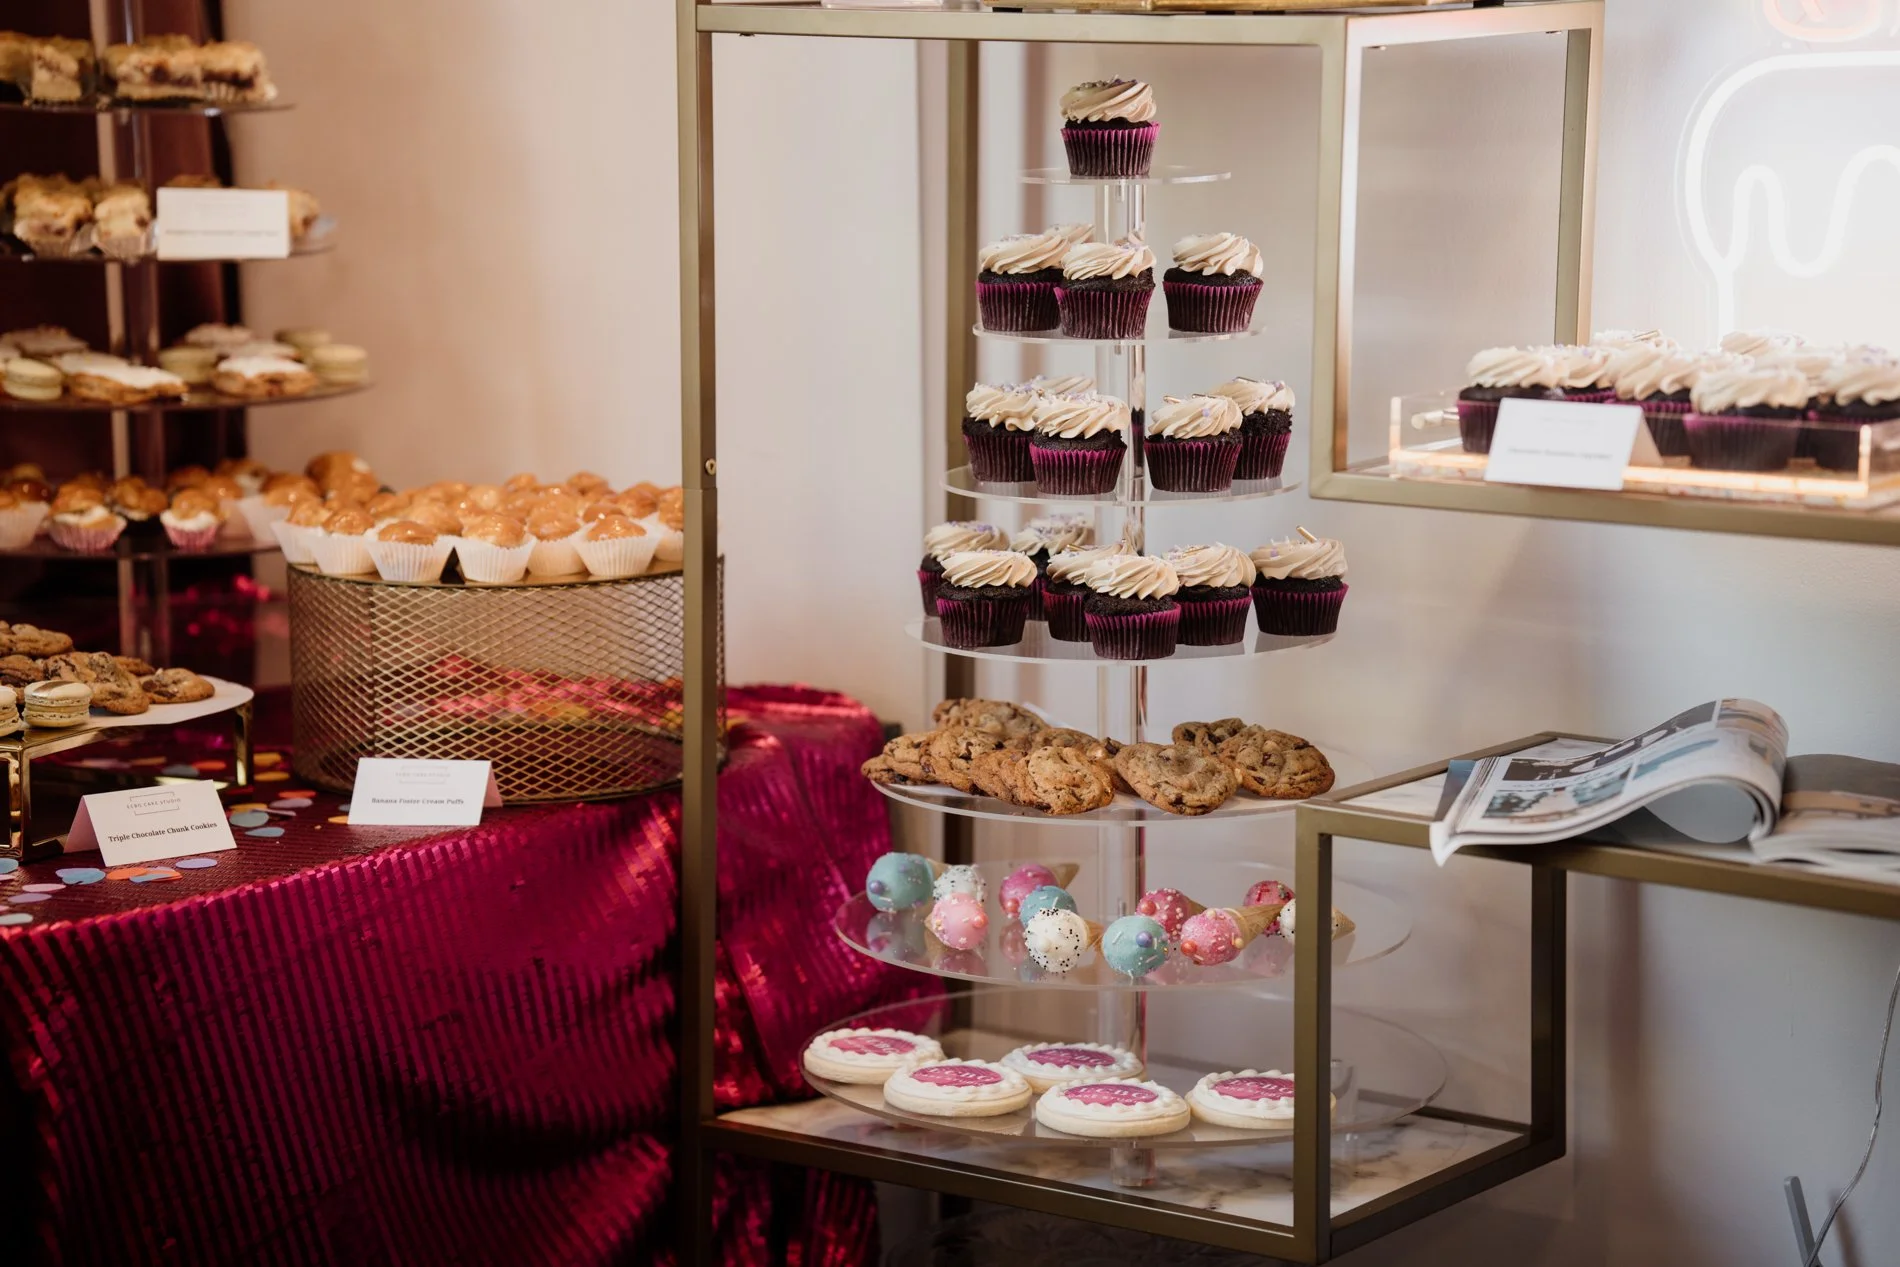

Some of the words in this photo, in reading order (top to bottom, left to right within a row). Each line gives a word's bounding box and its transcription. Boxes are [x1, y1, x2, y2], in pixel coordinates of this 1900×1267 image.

[144, 800, 158, 808] CAKE
[160, 797, 181, 806] STUDIO
[108, 832, 130, 843] Triple
[131, 828, 166, 840] Chocolate
[167, 825, 190, 834] Chunk
[190, 821, 218, 832] Cookies
